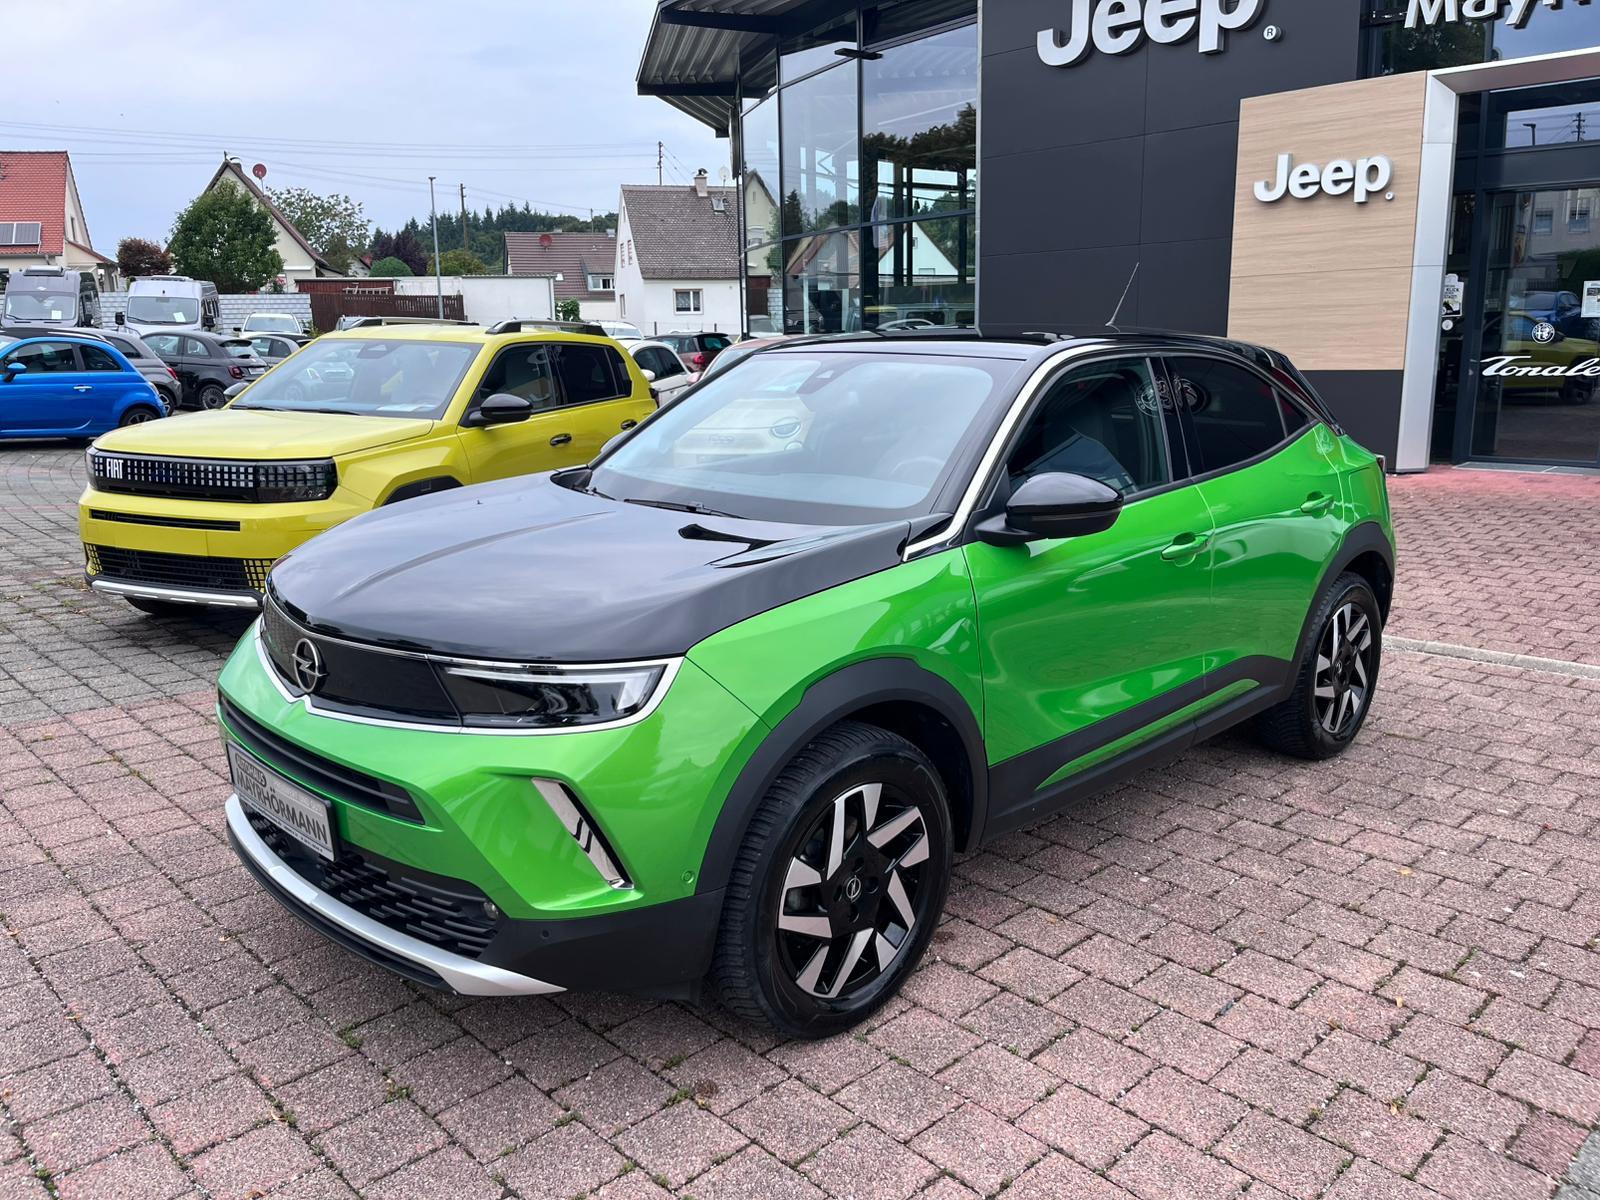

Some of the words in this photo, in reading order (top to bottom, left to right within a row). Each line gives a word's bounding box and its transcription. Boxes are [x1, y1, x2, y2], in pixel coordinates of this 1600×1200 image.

[1036, 0, 1264, 66] Jeep
[1253, 153, 1392, 203] Jeep
[1480, 355, 1600, 376] Tonale
[106, 458, 124, 479] FIAT
[236, 767, 328, 845] MAYRHÖRMANN
